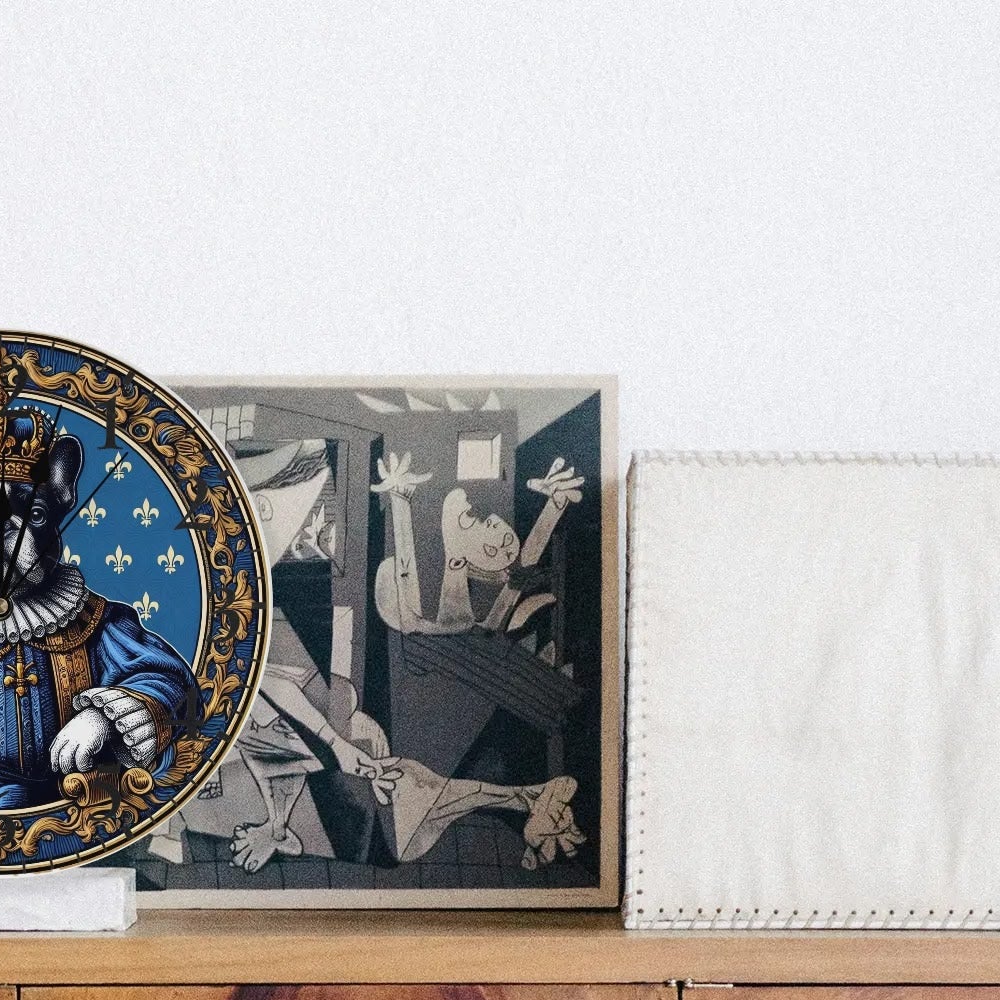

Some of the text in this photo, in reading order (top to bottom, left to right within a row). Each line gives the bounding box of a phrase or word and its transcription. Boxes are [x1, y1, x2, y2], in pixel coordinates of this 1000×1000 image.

[97, 394, 123, 449] 1
[175, 477, 212, 530] 2
[209, 584, 241, 641] 3
[166, 687, 205, 741] 4
[90, 764, 122, 818] 5
